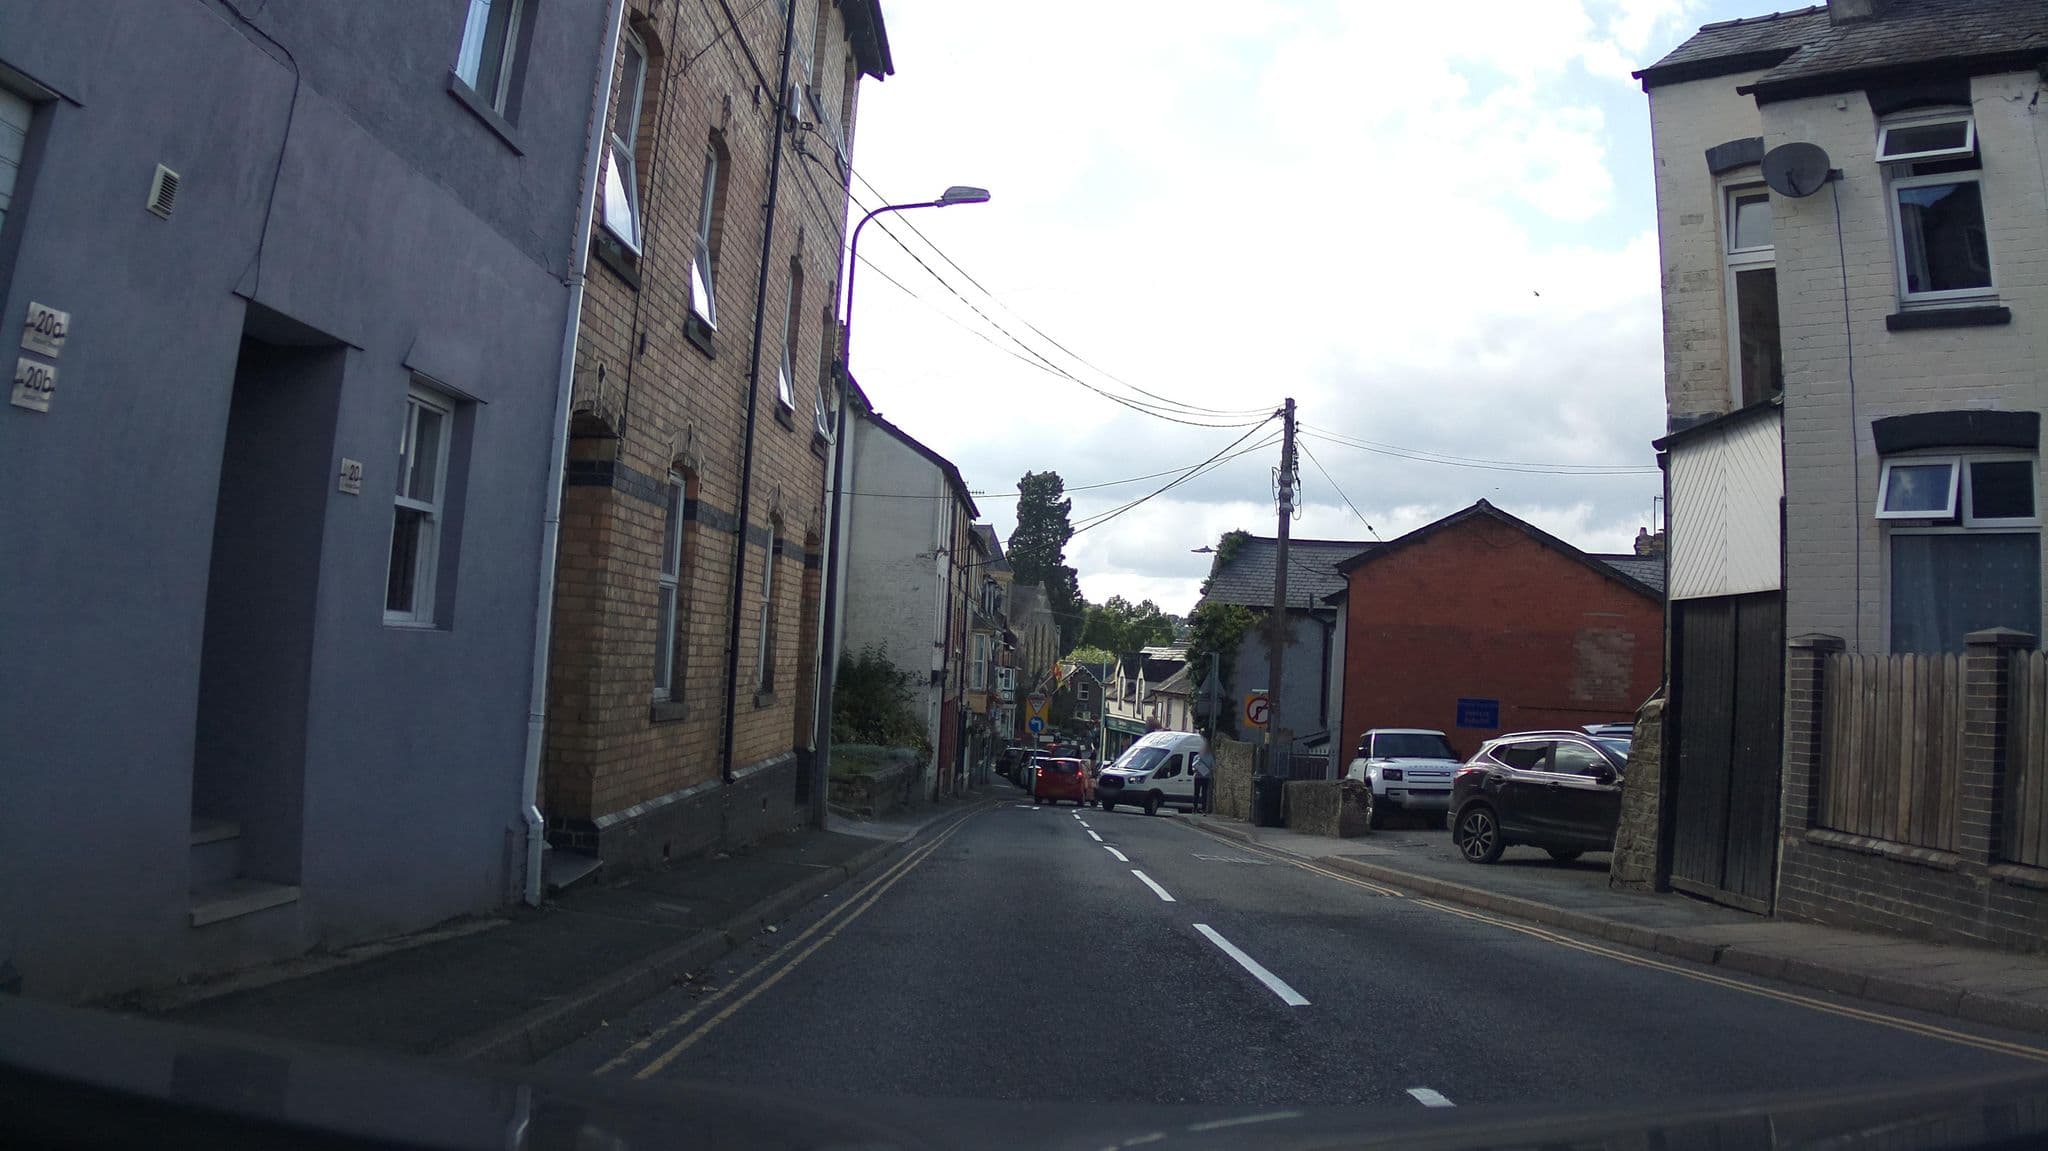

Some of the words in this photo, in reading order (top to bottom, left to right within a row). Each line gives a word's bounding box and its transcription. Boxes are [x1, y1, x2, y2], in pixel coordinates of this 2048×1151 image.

[35, 310, 62, 338] 20a
[24, 366, 51, 392] 20b
[349, 464, 360, 482] 20
